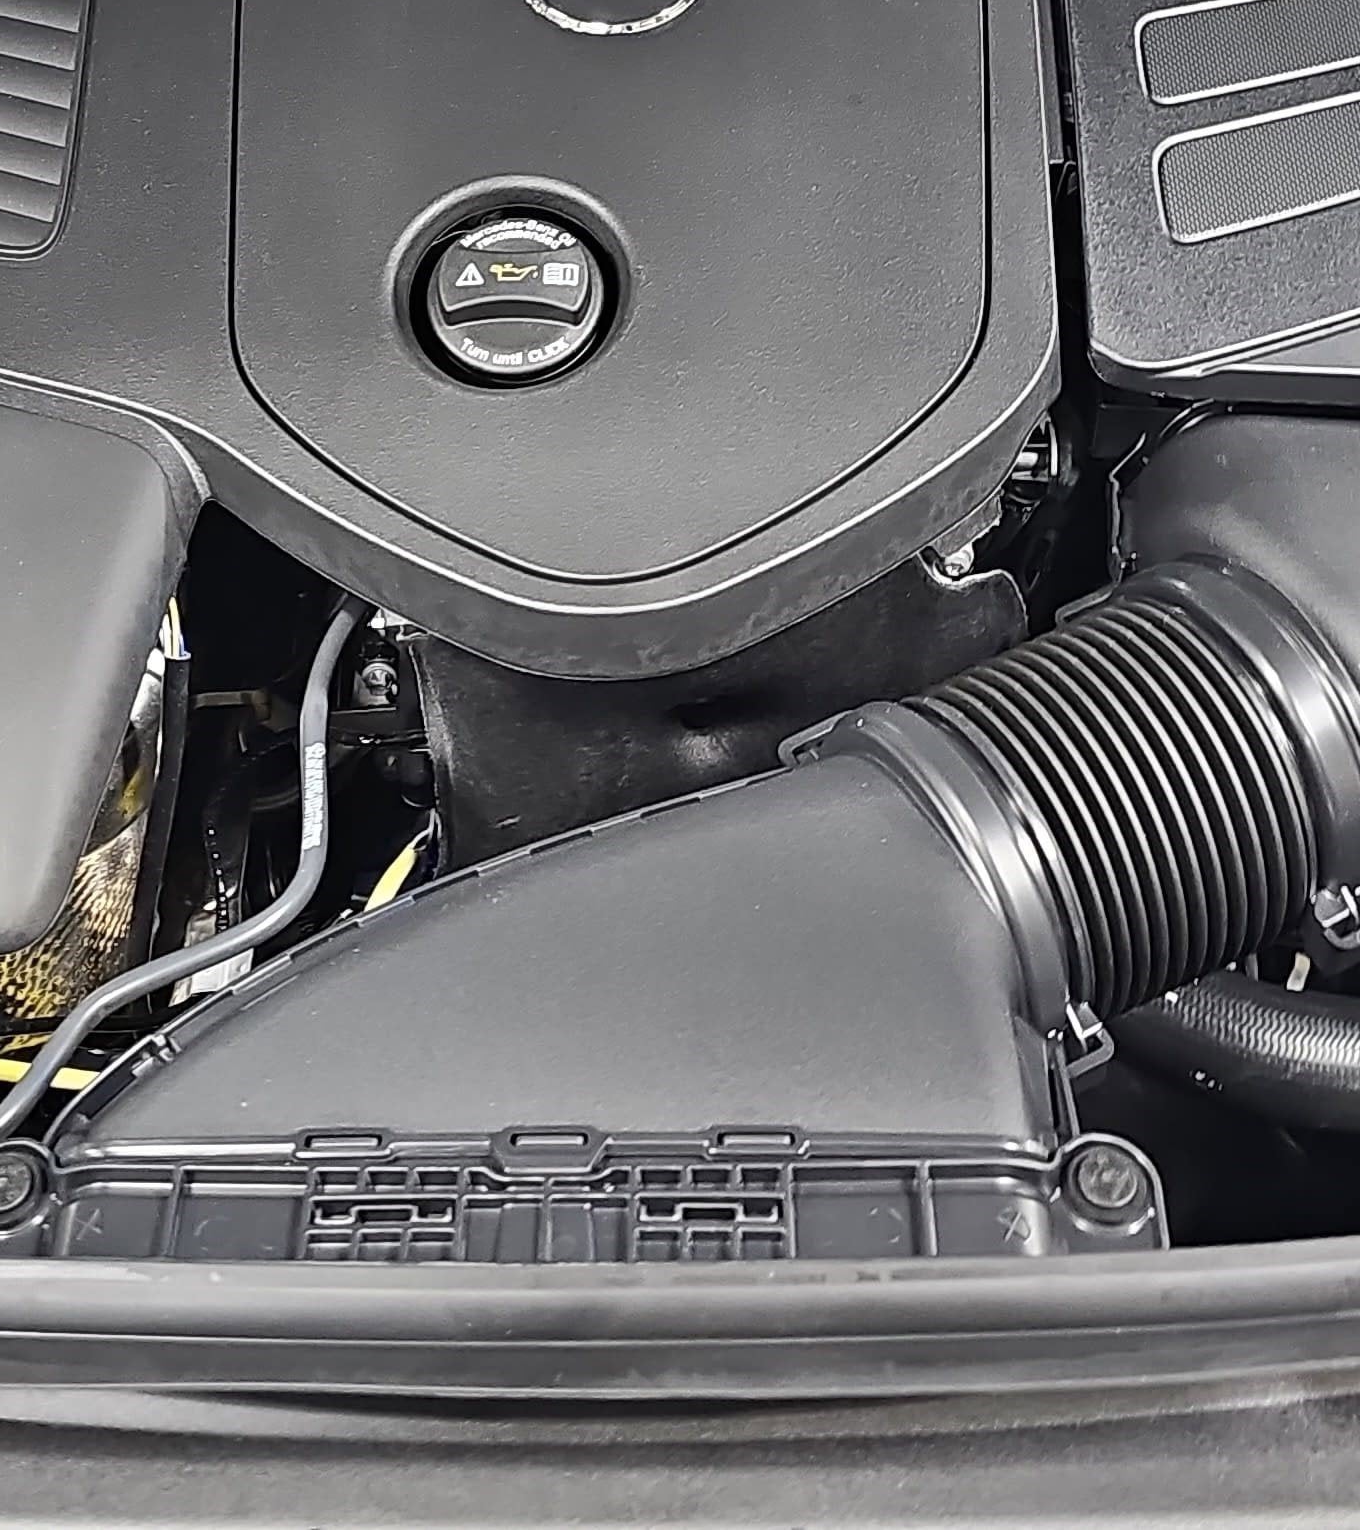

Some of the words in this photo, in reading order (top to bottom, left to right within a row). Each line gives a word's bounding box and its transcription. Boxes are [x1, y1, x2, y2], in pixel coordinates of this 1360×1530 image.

[476, 230, 560, 250] recommended
[460, 337, 489, 362] Turn
[492, 351, 523, 366] until
[527, 337, 570, 363] CLICK
